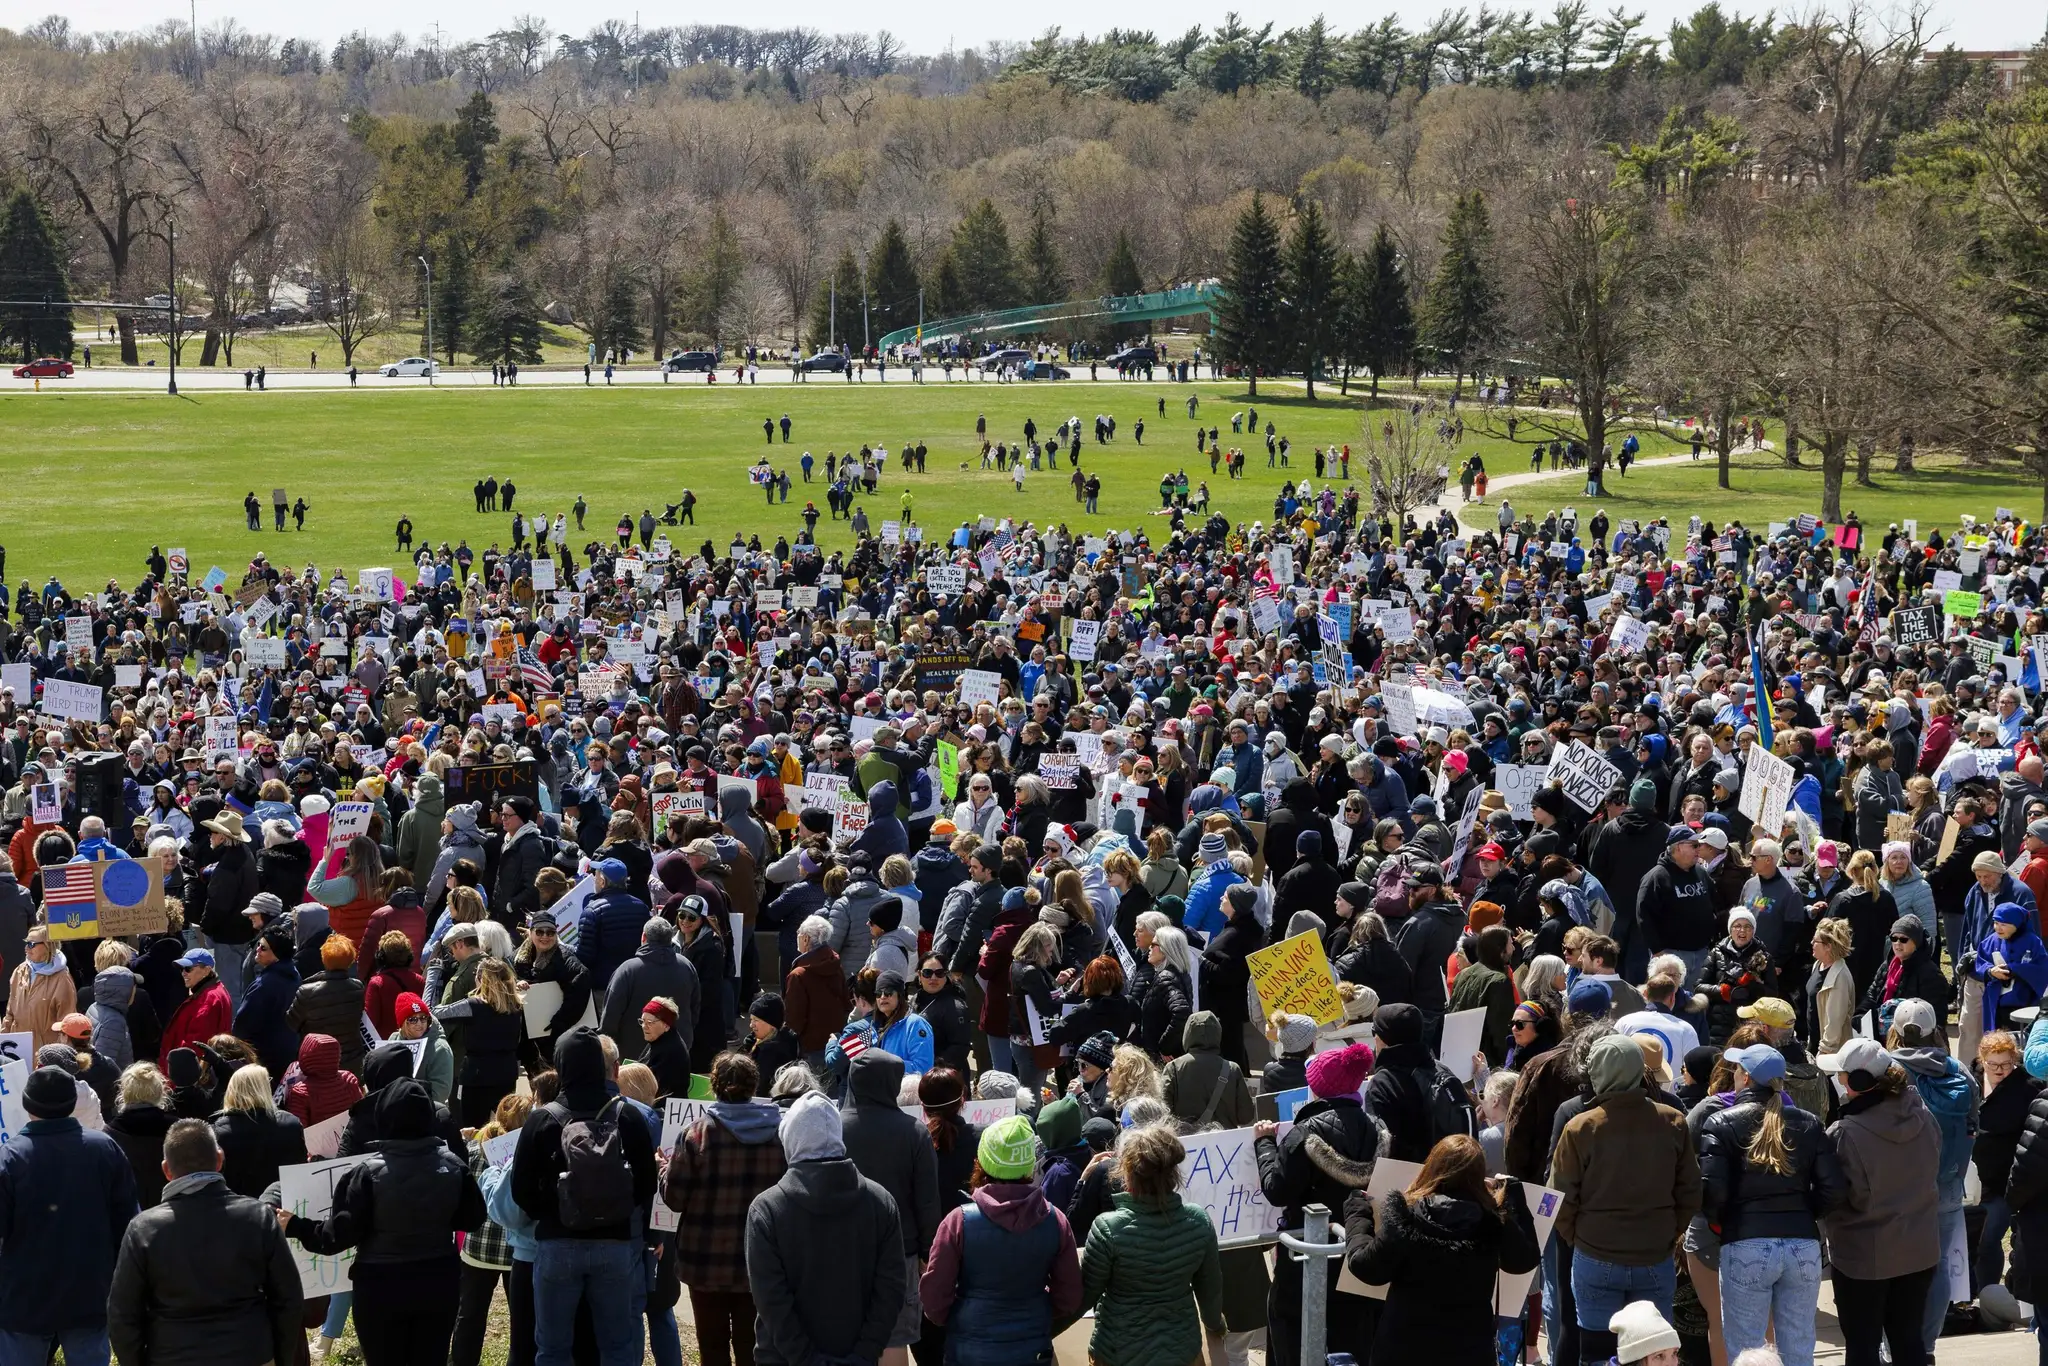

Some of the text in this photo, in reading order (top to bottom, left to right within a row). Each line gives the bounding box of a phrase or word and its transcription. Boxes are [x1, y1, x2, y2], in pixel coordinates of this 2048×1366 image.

[977, 547, 996, 559] HANDS
[984, 552, 996, 562] OFF
[1900, 610, 1927, 622] TAX.
[1076, 626, 1094, 636] OFF!
[1316, 614, 1342, 644] FIGHT
[1901, 620, 1928, 632] THE.
[1901, 630, 1932, 643] RICH.
[1973, 646, 1990, 655] HANDS
[1973, 652, 1990, 664] OFF!
[1326, 662, 1347, 690] DECAY
[46, 682, 100, 699] NO TRUMP
[44, 696, 98, 714] THIRD TERM
[41, 722, 62, 732] HAND
[214, 718, 236, 732] POWER
[1072, 735, 1082, 745] SO
[1974, 749, 2013, 757] ANDS
[1044, 754, 1080, 766] ORGANIZE
[1976, 756, 2002, 765] OFF
[1046, 766, 1073, 777] agitate
[1564, 744, 1618, 790] NO KINGS
[1748, 748, 1790, 794] DOGE
[1977, 766, 1999, 779] VA
[466, 767, 532, 793] FUCK!
[807, 776, 826, 790] DUE
[1042, 776, 1078, 787] EDUCATE
[1506, 768, 1544, 790] OBE
[1548, 762, 1604, 808] NO NAZIS
[653, 795, 671, 816] STOP
[808, 793, 820, 807] FOR
[824, 796, 836, 811] ALL
[34, 805, 61, 815] HITLER
[851, 804, 867, 815] NOT
[35, 812, 54, 821] WANNA
[1675, 881, 1706, 898] LOVE
[100, 910, 120, 920] ELON
[1253, 960, 1273, 980] this
[1274, 946, 1284, 958] is
[1258, 940, 1314, 1001] WINNING
[1272, 968, 1317, 1010] what does
[1284, 974, 1331, 1014] OSING
[1315, 989, 1334, 1013] like?
[1227, 1184, 1263, 1206] the
